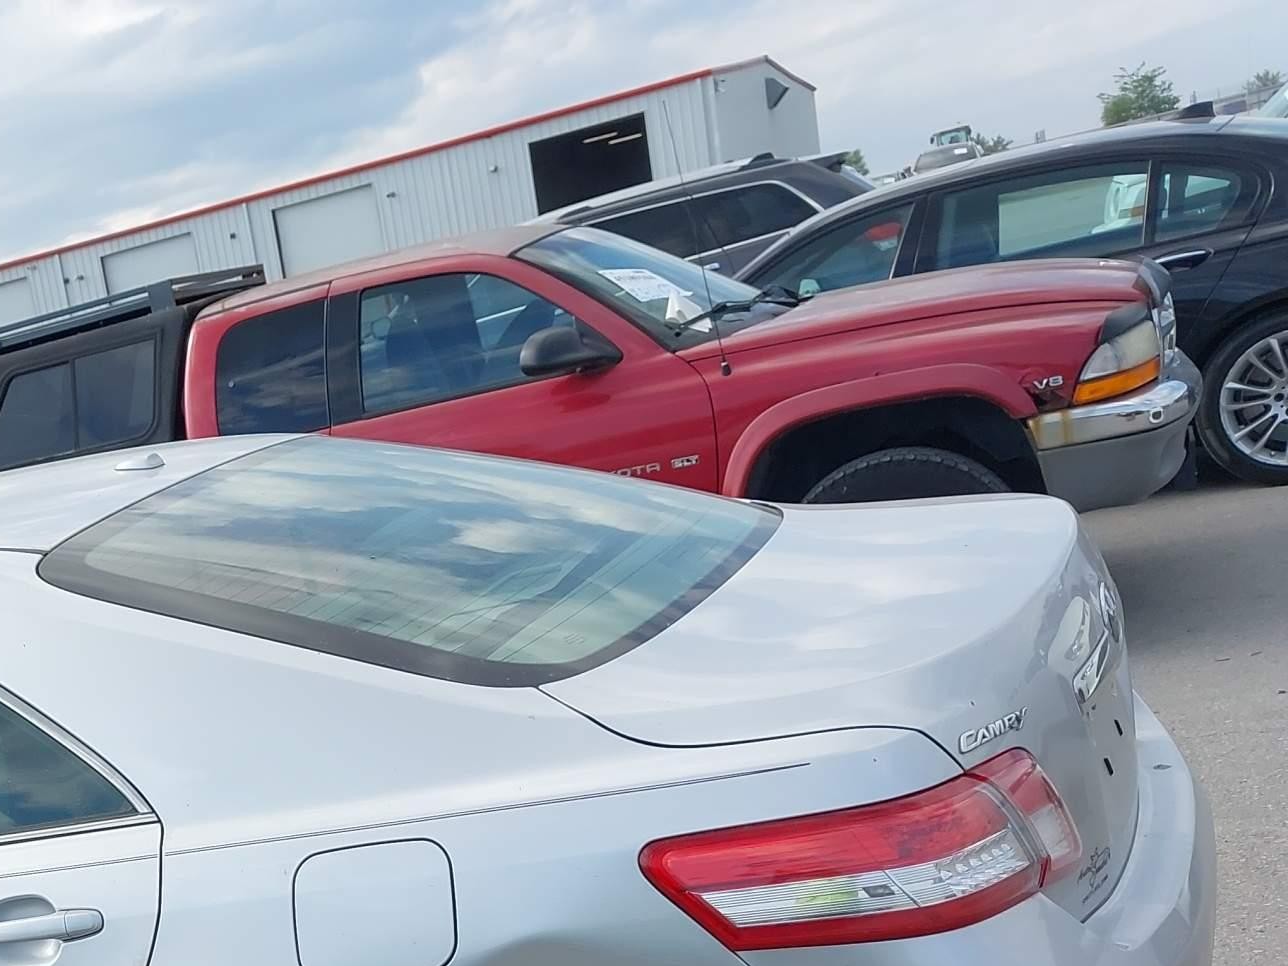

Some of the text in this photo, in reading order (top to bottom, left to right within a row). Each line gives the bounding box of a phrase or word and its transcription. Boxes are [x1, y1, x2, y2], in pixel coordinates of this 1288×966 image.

[1032, 375, 1064, 390] V8
[610, 462, 661, 478] OTA
[959, 706, 1028, 754] CAMRY
